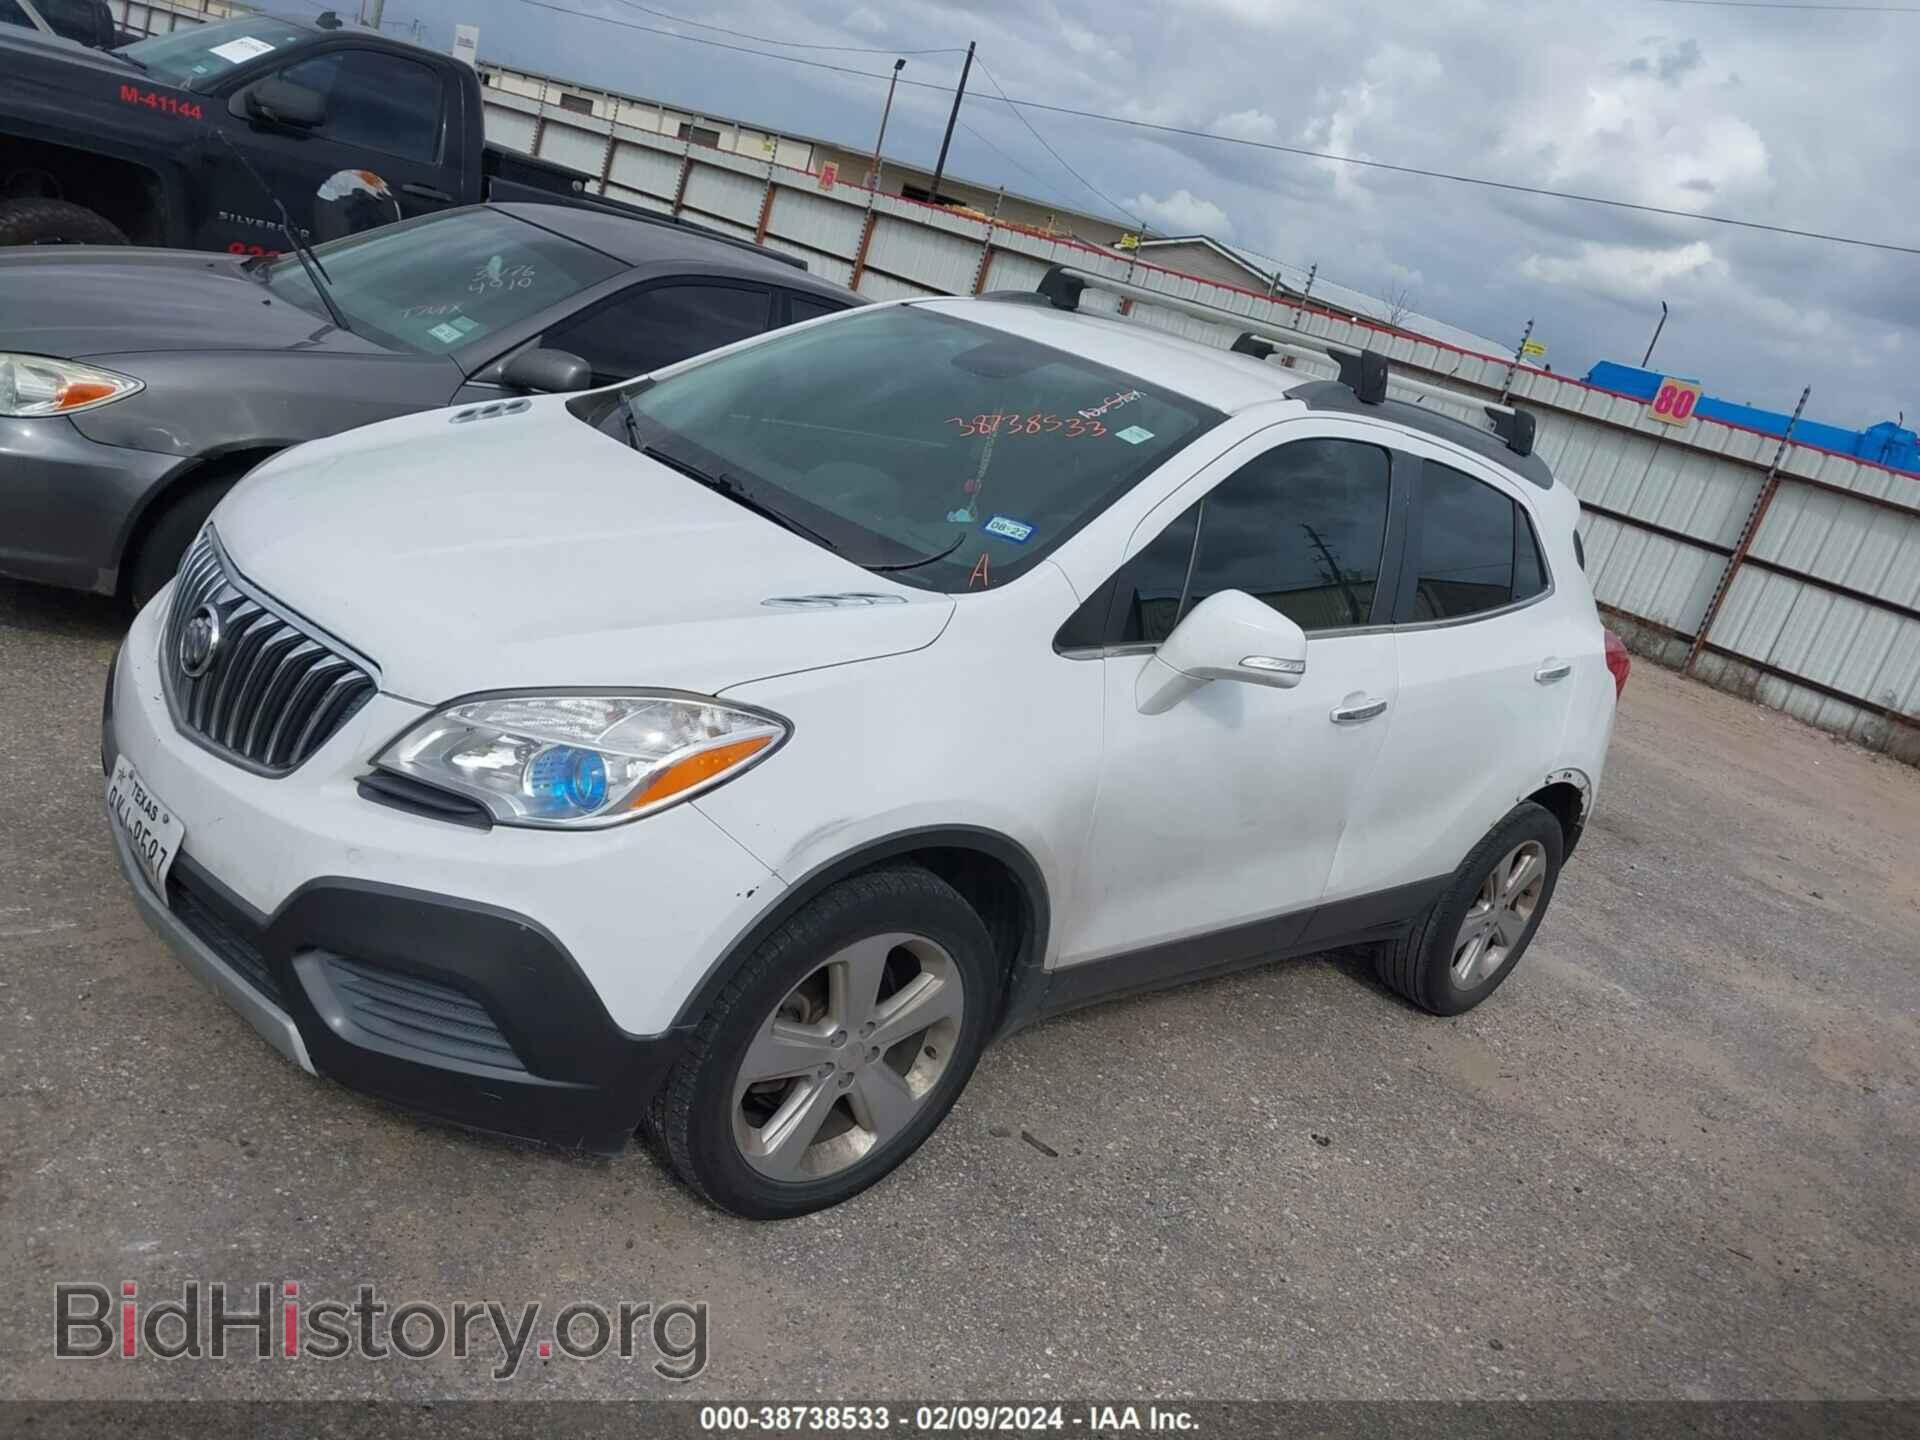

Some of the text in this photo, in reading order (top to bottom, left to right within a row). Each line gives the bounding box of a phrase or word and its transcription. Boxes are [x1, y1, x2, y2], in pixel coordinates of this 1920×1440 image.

[119, 84, 204, 121] M-41144
[1653, 384, 1697, 420] 80
[944, 413, 1108, 439] 38738533
[968, 552, 990, 588] A
[130, 780, 159, 823] TEXAS
